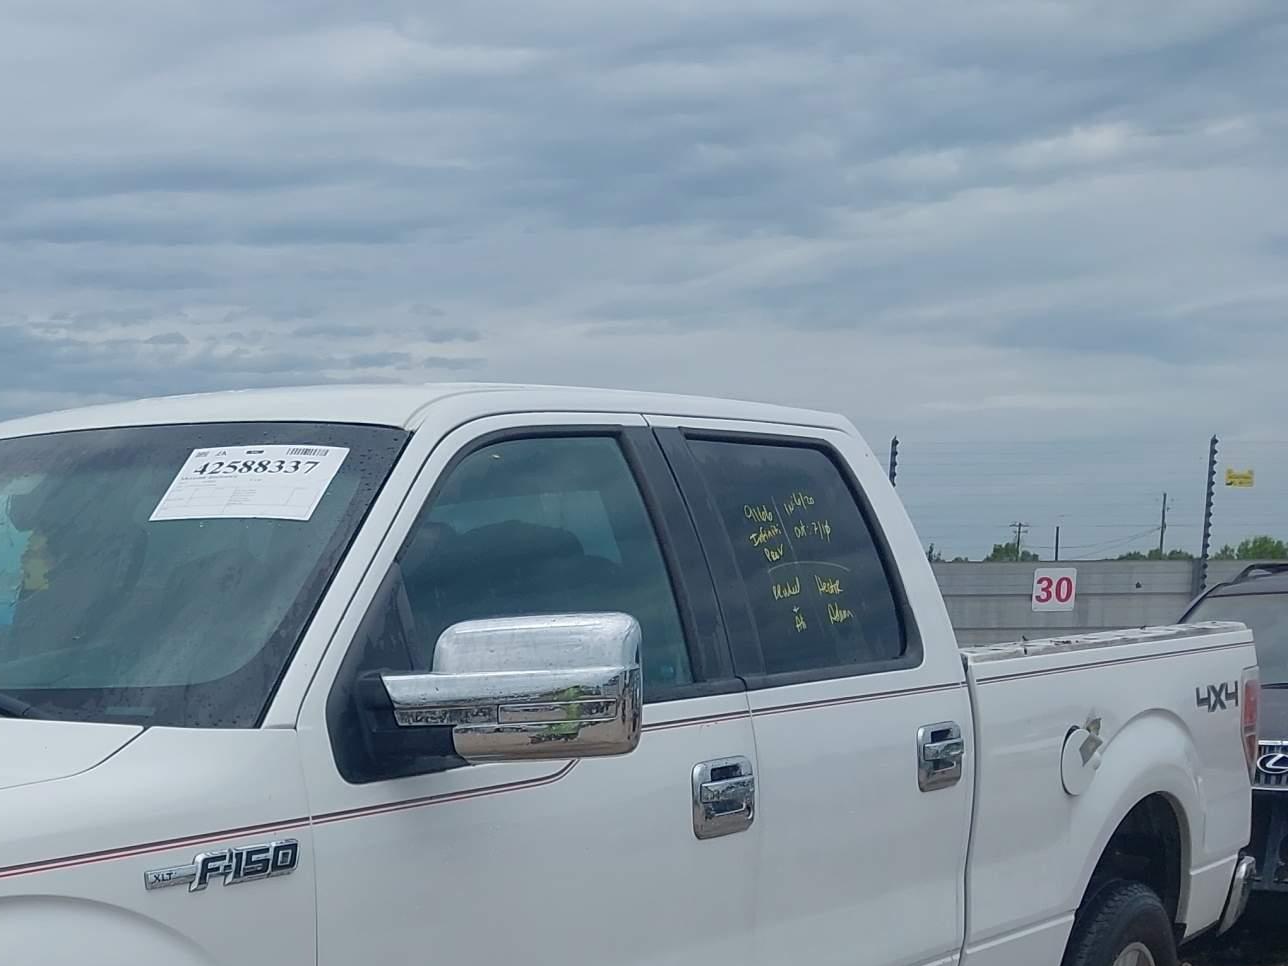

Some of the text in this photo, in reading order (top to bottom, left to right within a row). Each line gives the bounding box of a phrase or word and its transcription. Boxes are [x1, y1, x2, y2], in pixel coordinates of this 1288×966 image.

[194, 459, 321, 475] 42588337
[1035, 576, 1073, 603] 30
[151, 838, 299, 892] XLT F-150
